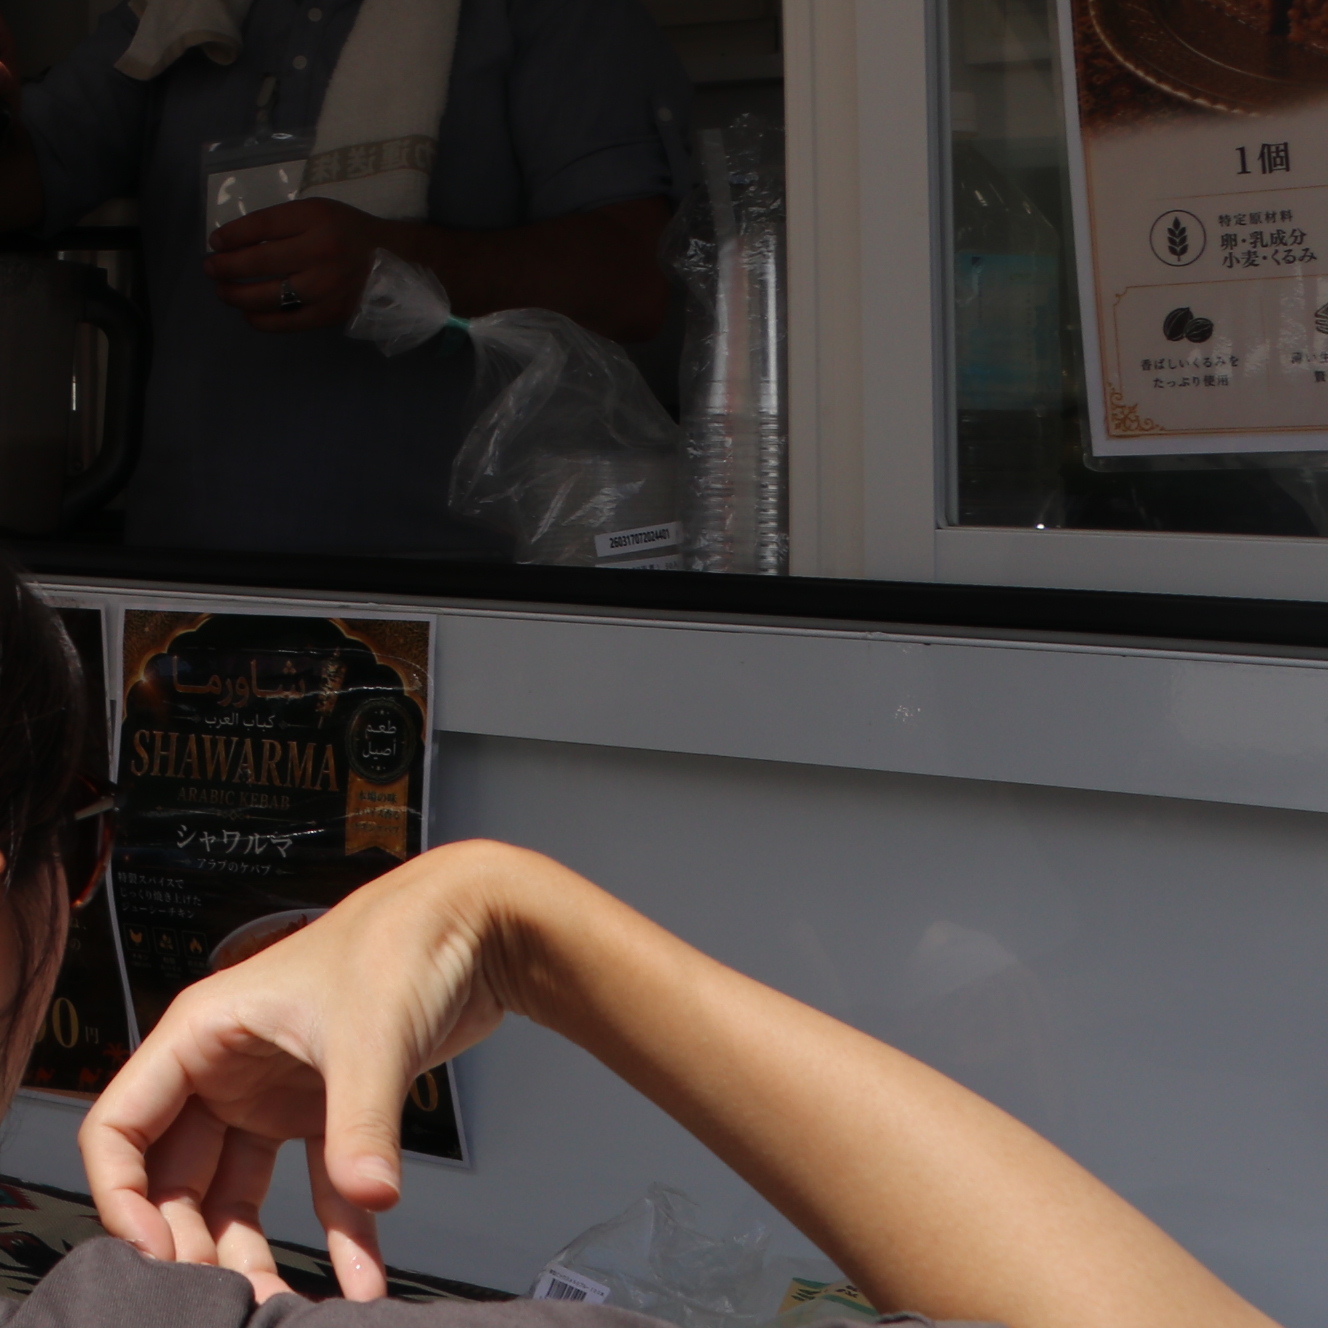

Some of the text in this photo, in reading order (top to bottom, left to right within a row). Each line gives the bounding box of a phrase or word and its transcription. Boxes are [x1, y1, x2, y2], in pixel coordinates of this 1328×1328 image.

[1235, 141, 1290, 175] 1個
[1218, 209, 1294, 227] 特定原材料
[1220, 228, 1307, 251] 卵・乳成分
[1221, 247, 1317, 269] 小麦・くるみ
[1140, 355, 1239, 371] 香ばしいくるみを
[1153, 374, 1230, 389] たっぷり使用
[171, 654, 306, 708] شاورما
[130, 729, 340, 792] SHAWARMA
[177, 787, 291, 810] ARABIC KEBAB
[176, 823, 293, 858] シャワルマ
[196, 858, 272, 875] アラブのケバブ
